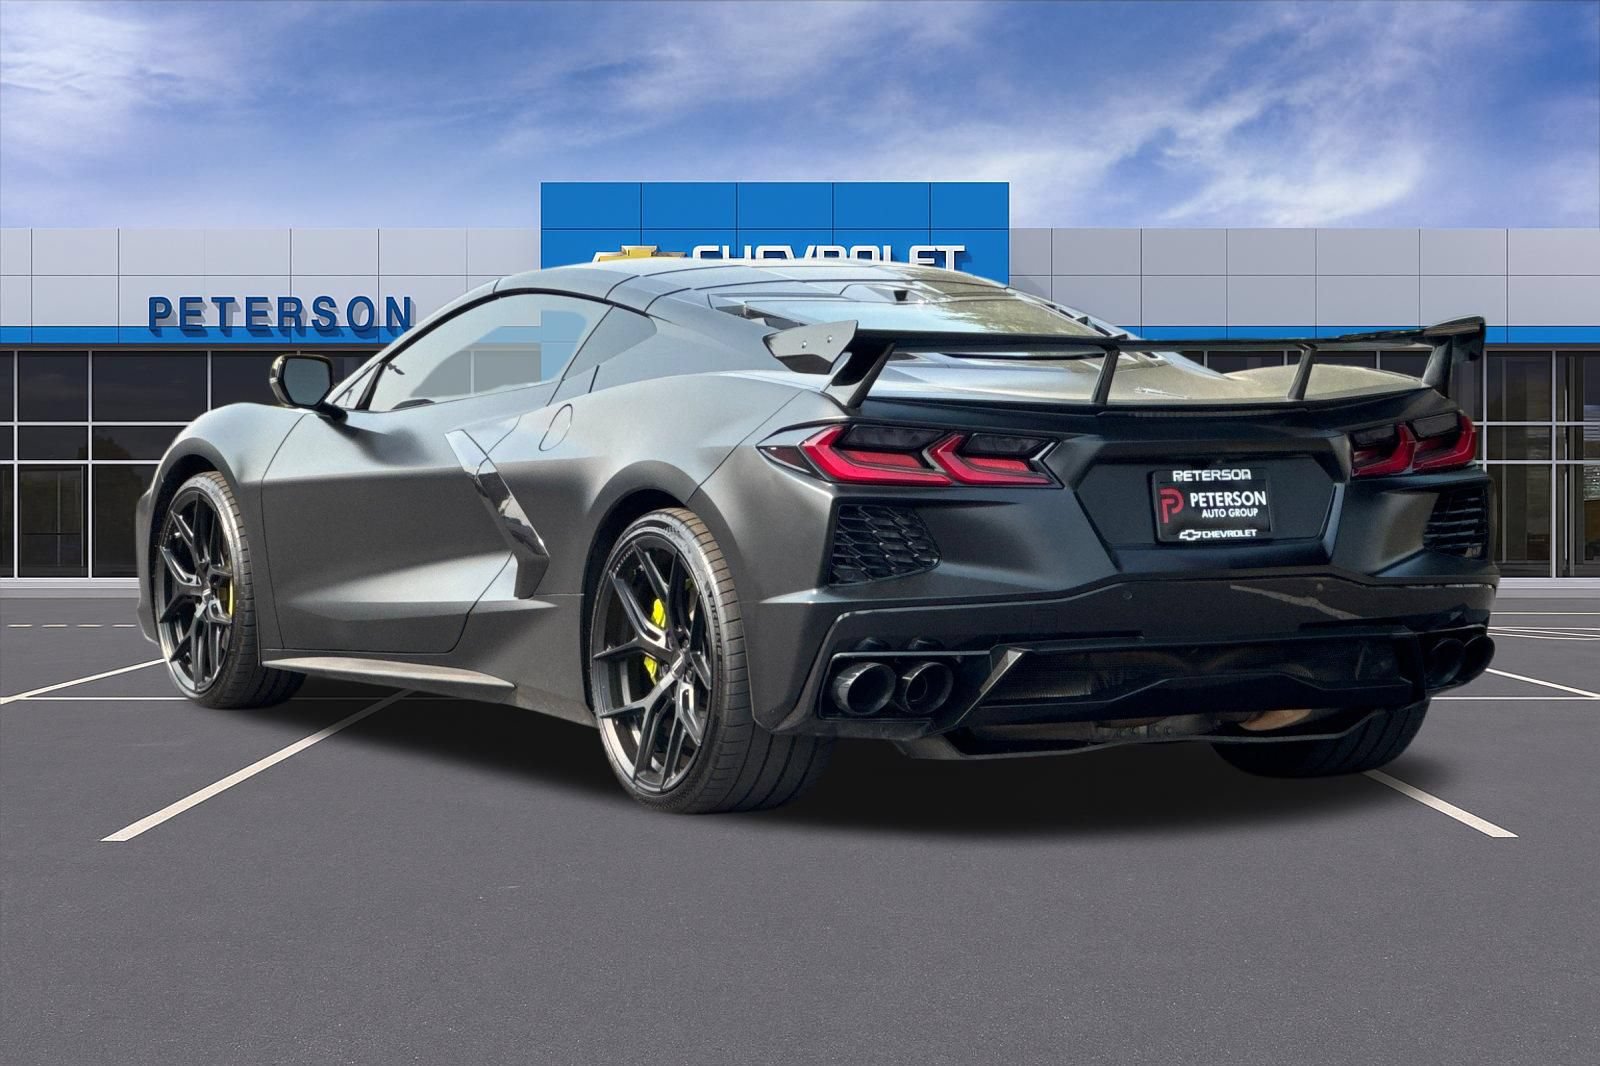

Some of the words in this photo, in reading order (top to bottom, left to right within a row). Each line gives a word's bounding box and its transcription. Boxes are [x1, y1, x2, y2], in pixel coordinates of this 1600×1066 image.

[148, 296, 411, 332] PETERSON
[1190, 491, 1267, 507] PETERSON
[1201, 508, 1226, 518] AUTO
[1228, 508, 1259, 518] GROUP
[1202, 529, 1258, 538] CHEVROLET
